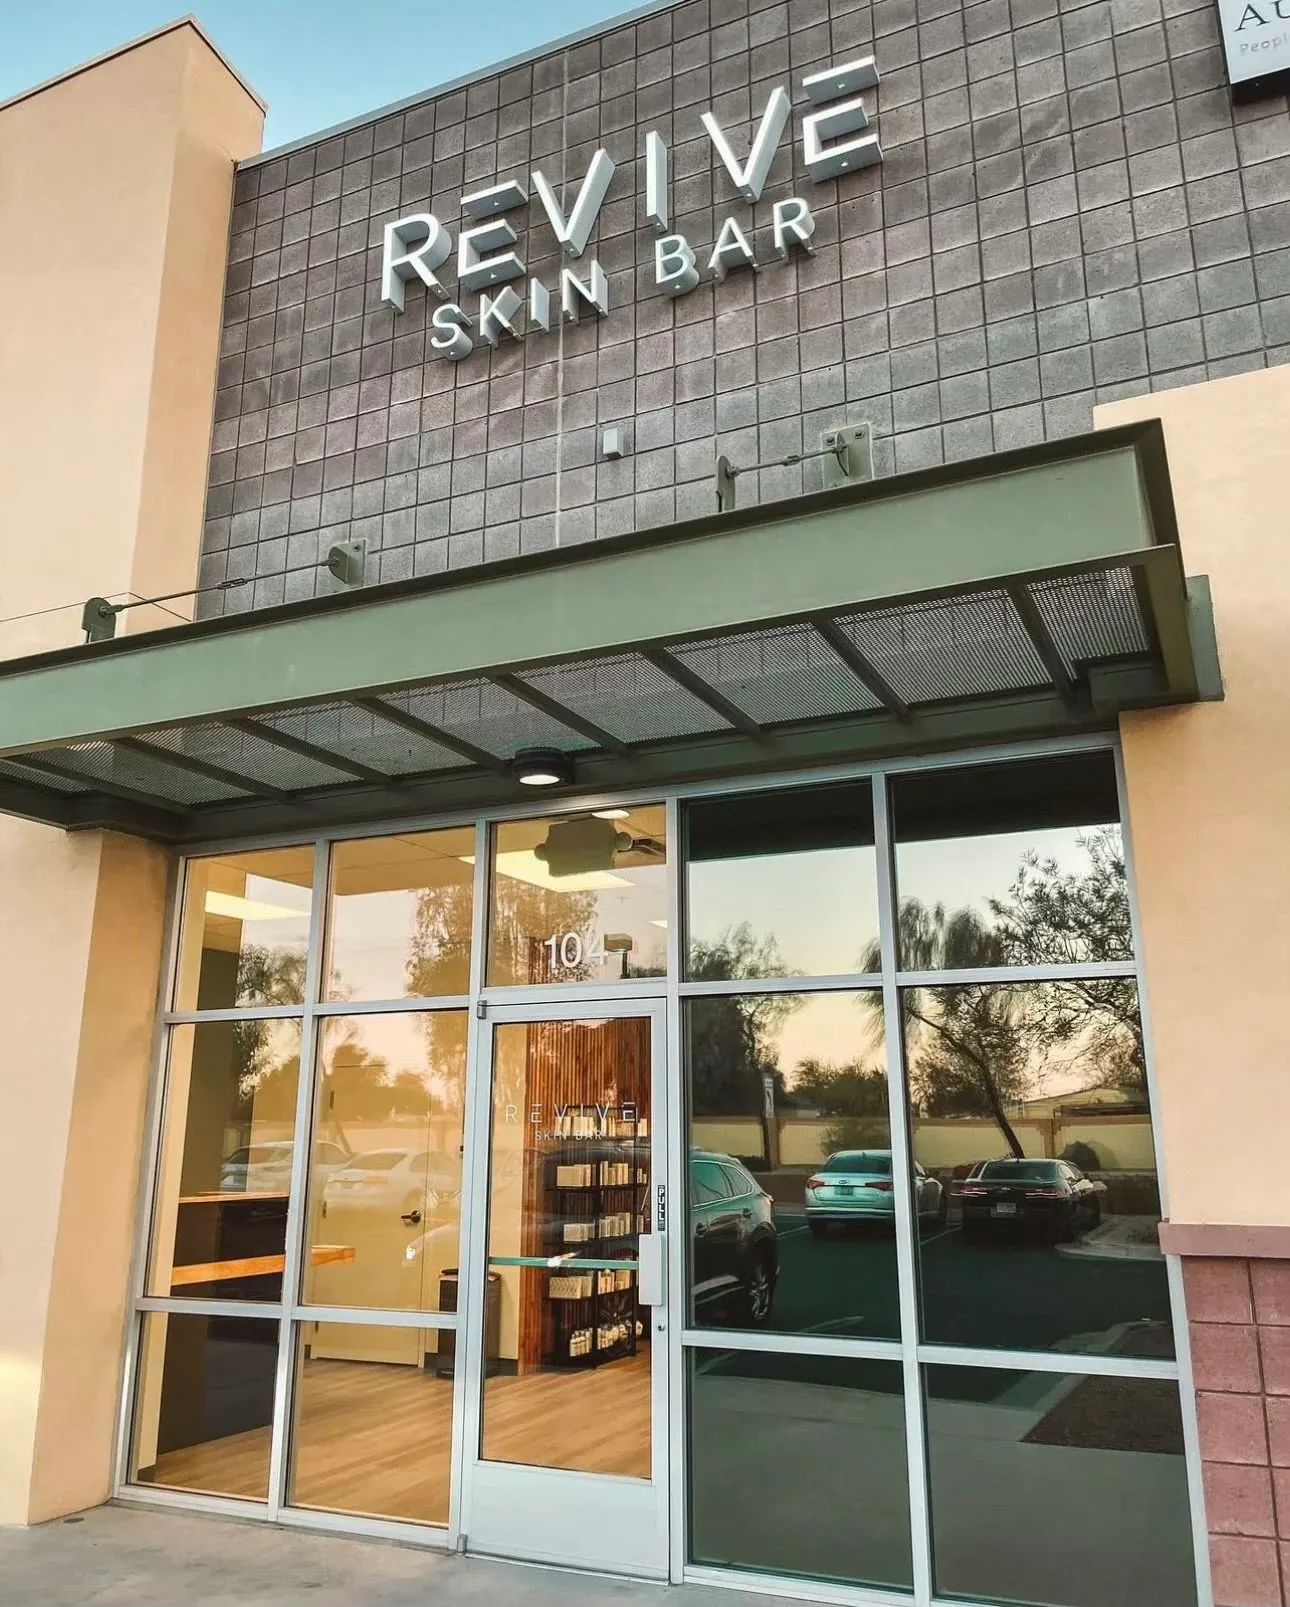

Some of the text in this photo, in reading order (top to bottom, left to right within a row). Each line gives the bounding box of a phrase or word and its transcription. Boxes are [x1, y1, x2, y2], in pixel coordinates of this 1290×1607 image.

[381, 55, 884, 313] REVIVE
[430, 197, 817, 361] SKIN BAR
[544, 930, 609, 969] 104
[505, 1101, 636, 1124] REVIVE
[534, 1130, 602, 1141] SKIN BAR
